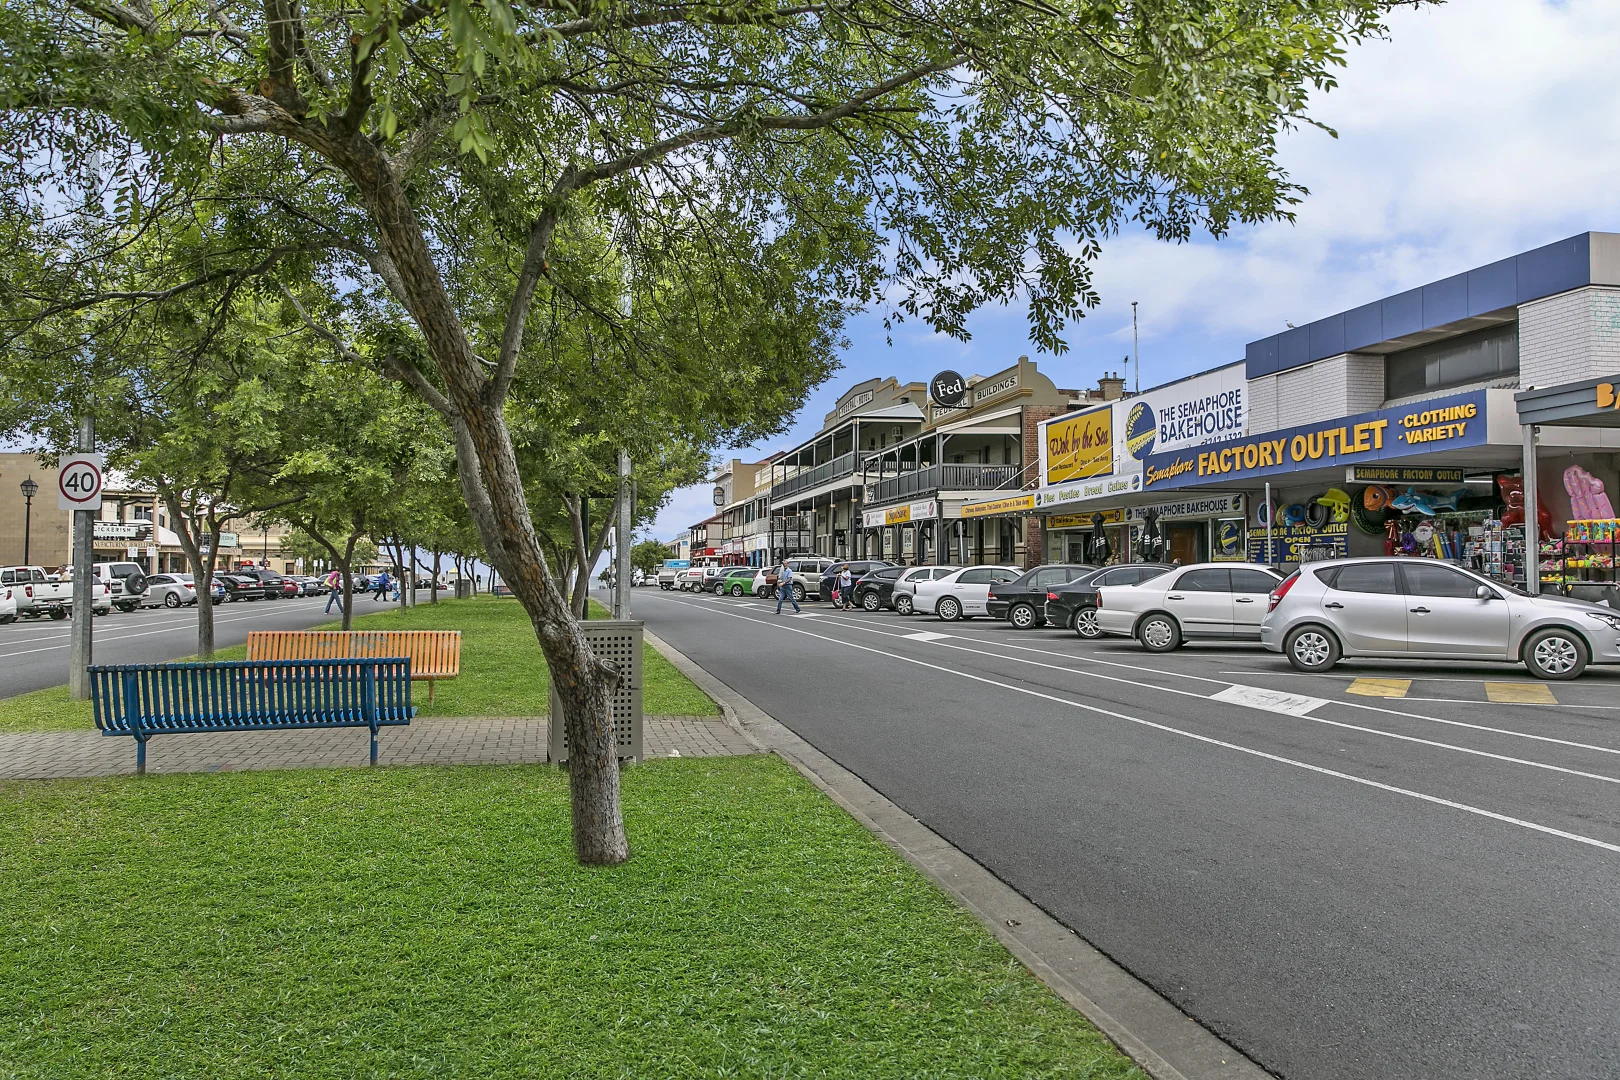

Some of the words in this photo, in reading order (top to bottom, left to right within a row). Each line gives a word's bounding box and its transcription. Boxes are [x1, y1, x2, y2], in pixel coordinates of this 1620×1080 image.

[937, 379, 963, 398] Fed
[841, 397, 857, 415] FEDERAL
[858, 393, 871, 405] HOTEL
[1160, 406, 1176, 423] THE
[1178, 388, 1241, 419] SEMAPHORE
[1160, 406, 1242, 444] BAKEHOUSE
[1403, 403, 1477, 428] CLOTHING
[1050, 424, 1070, 456] Wok
[1071, 424, 1080, 463] by
[1082, 420, 1093, 450] the
[1094, 426, 1109, 447] Sea
[1405, 422, 1467, 444] VARIETY
[1146, 456, 1194, 486] Semaphore
[1198, 438, 1288, 476] FACTORY
[1290, 419, 1388, 463] OUTLET
[65, 472, 94, 492] 40
[1356, 468, 1399, 479] SEMAPHORE
[1403, 469, 1433, 479] FACTORY
[1436, 470, 1462, 480] OUTLET
[1043, 493, 1056, 503] Pies
[1060, 489, 1080, 501] Pasties
[1084, 484, 1103, 496] Bread
[1108, 480, 1128, 492] Cakes
[1186, 499, 1228, 515] BAKEHOUSE
